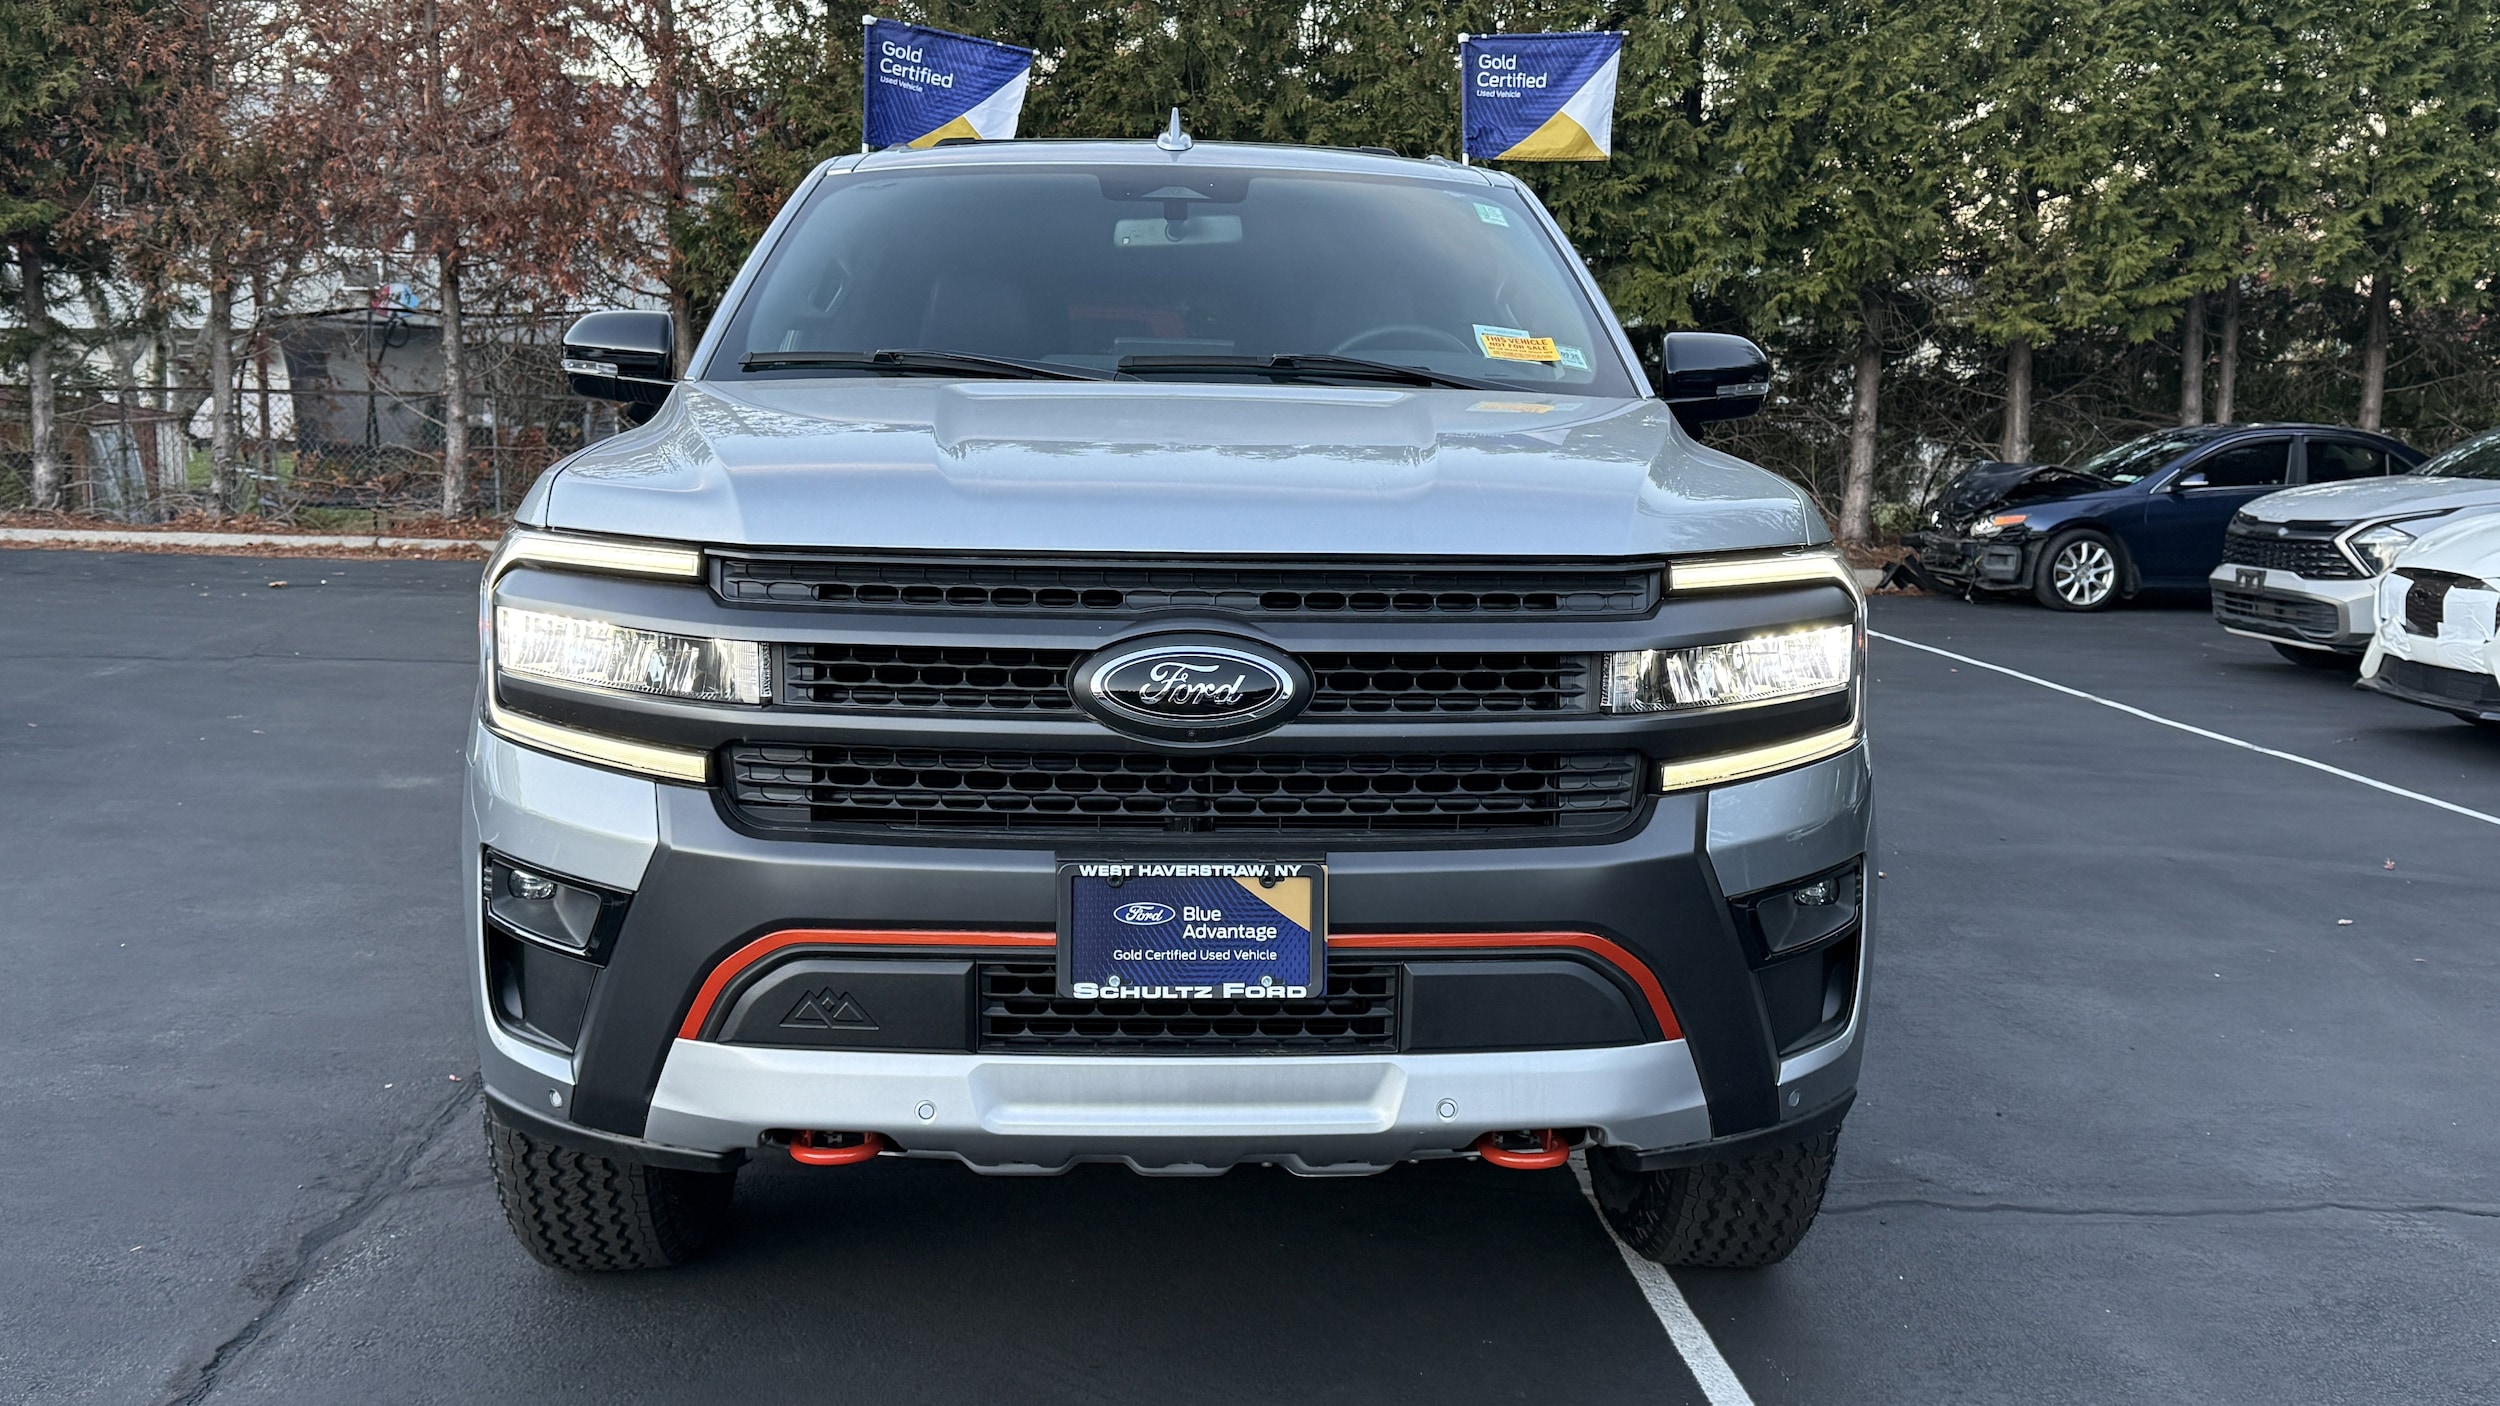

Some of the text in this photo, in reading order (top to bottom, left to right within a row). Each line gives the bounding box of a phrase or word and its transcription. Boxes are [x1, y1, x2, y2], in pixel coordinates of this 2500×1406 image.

[882, 41, 923, 63] Gold
[1478, 54, 1517, 70] Gold
[880, 58, 954, 88] Certified
[1477, 72, 1547, 88] Certified
[880, 75, 923, 92] Used Vehicle
[1476, 90, 1521, 98] Used Vehicle
[1139, 661, 1246, 705] Ford
[1079, 865, 1302, 877] WEST HAVERSTRAW, NY
[1125, 905, 1164, 922] Ford
[1183, 906, 1222, 922] Blue
[1183, 924, 1277, 942] Advantage
[1113, 950, 1277, 961] Gold Certified Used Vehicle
[1073, 982, 1308, 999] SCHULTZ FORD
